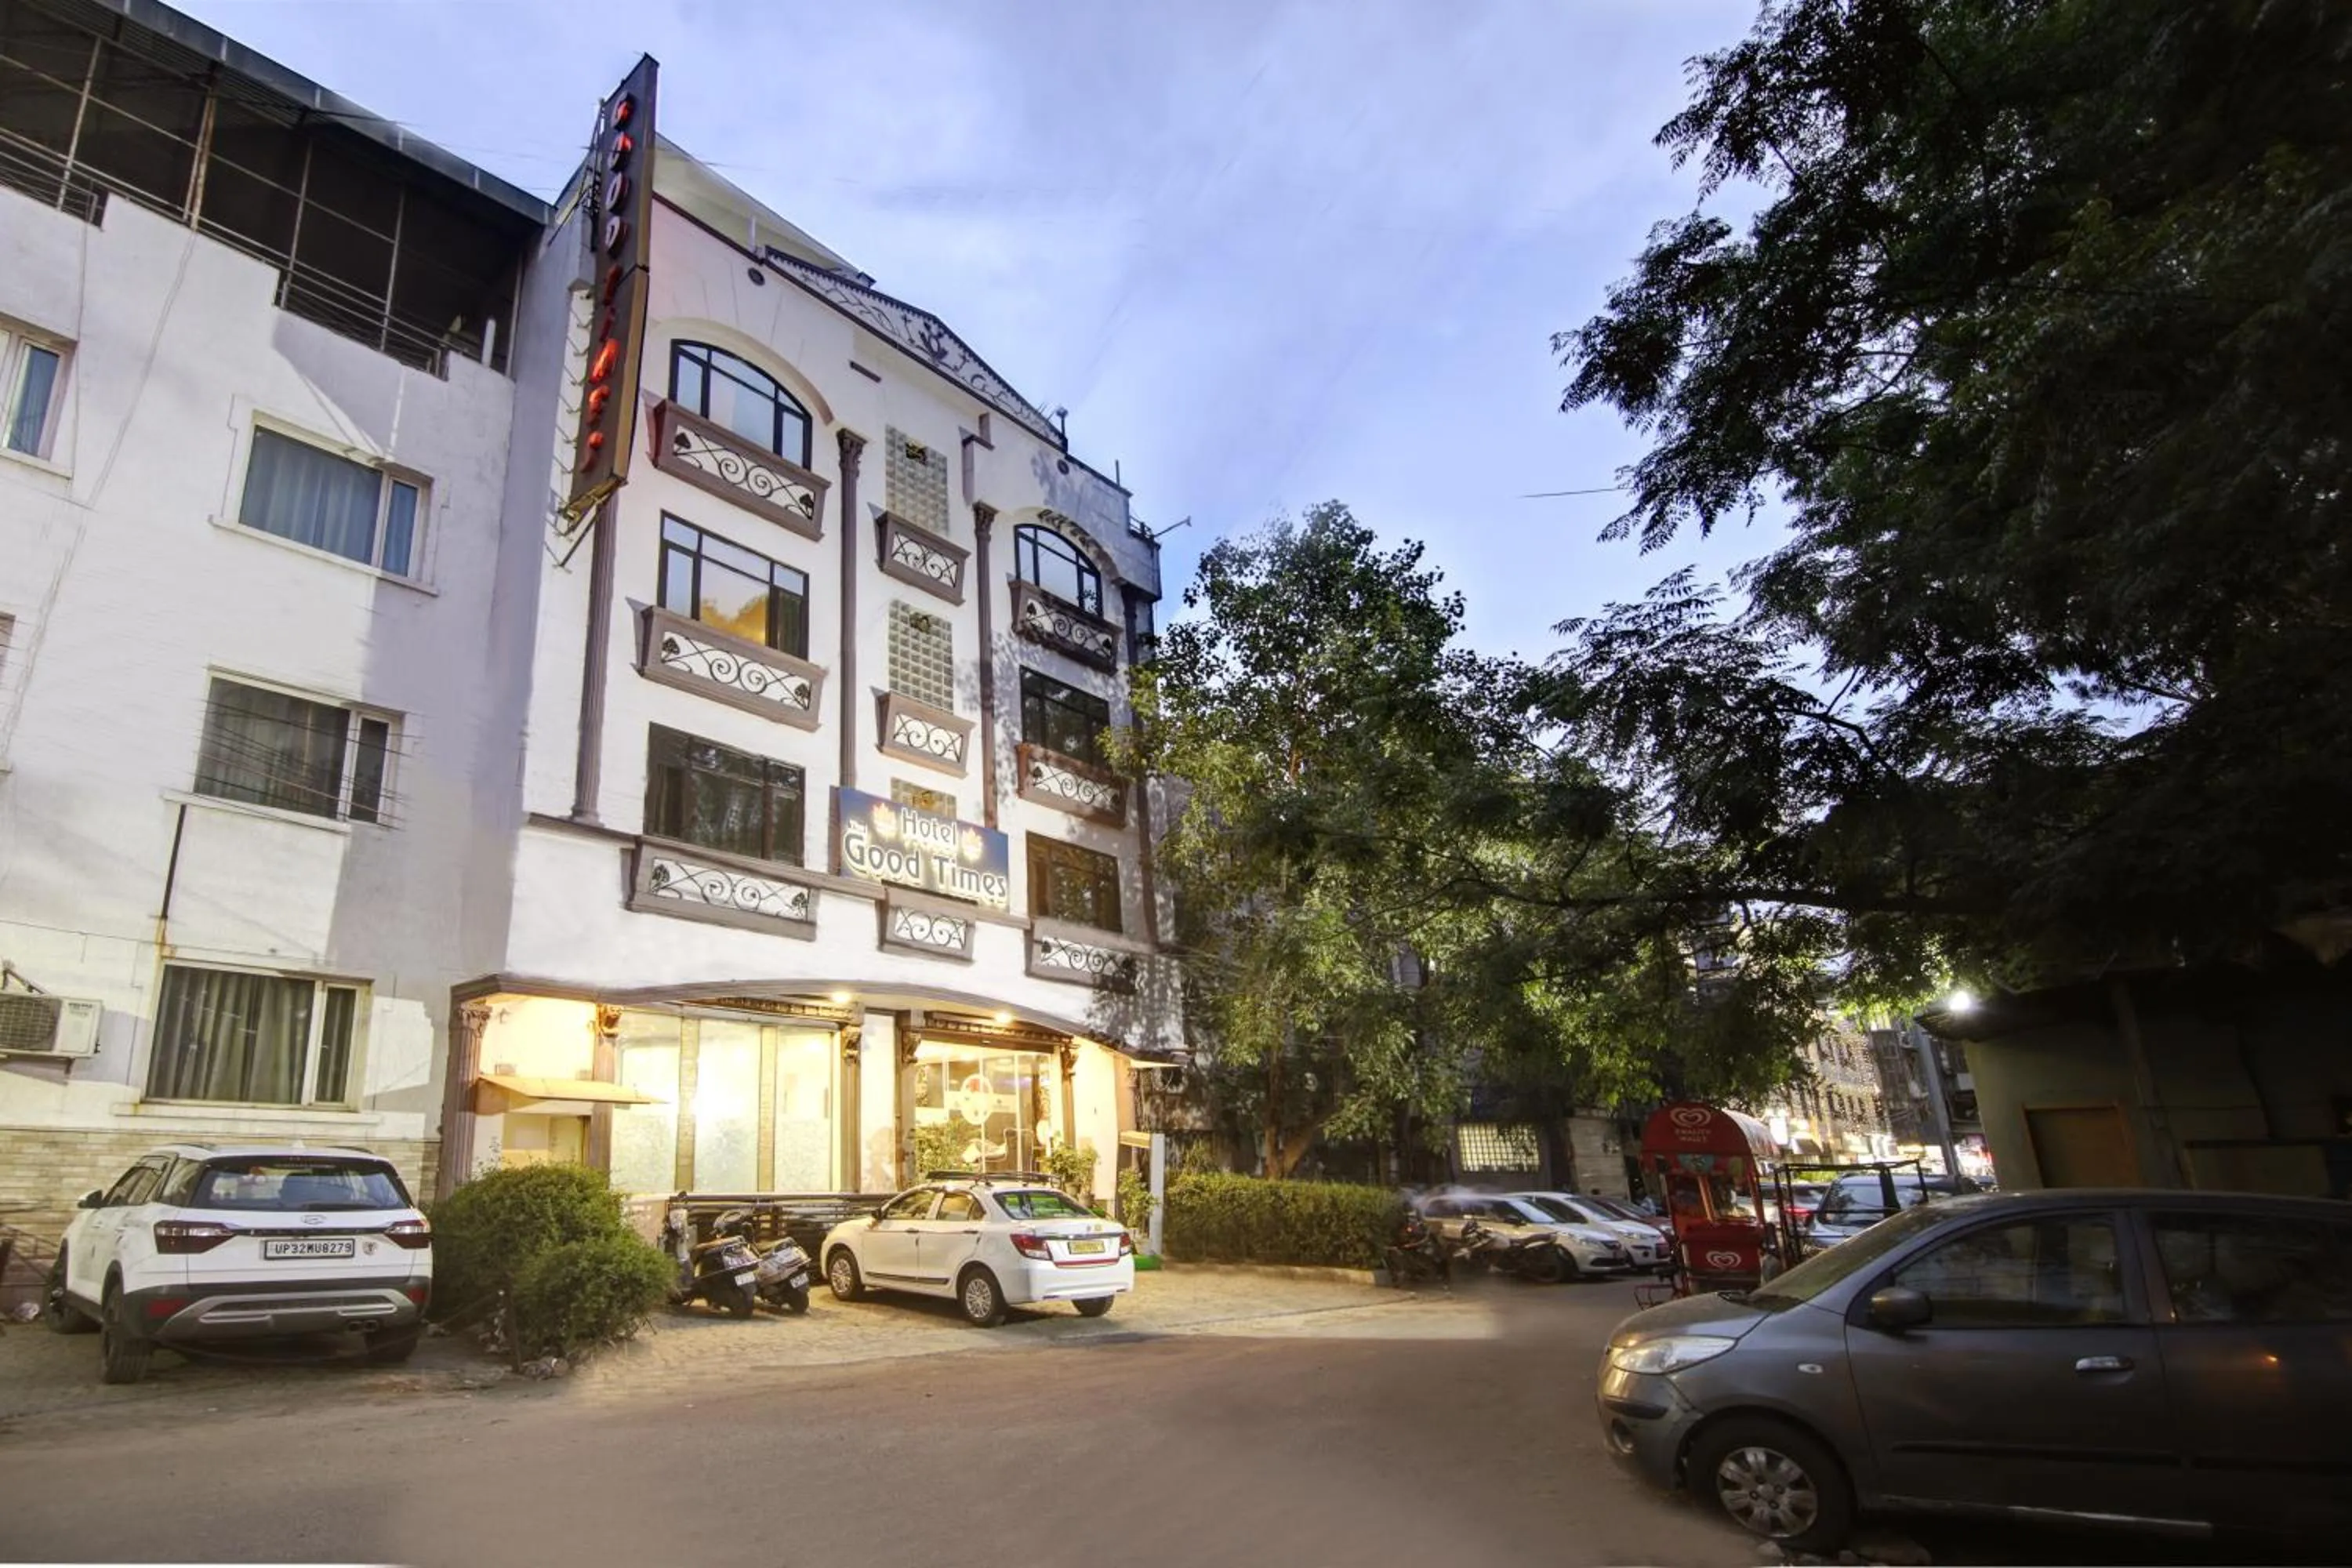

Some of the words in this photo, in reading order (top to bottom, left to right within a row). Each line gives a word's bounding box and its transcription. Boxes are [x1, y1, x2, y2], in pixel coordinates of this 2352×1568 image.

[902, 808, 956, 845] Hotel
[844, 829, 920, 879] Good
[933, 855, 1007, 898] Times
